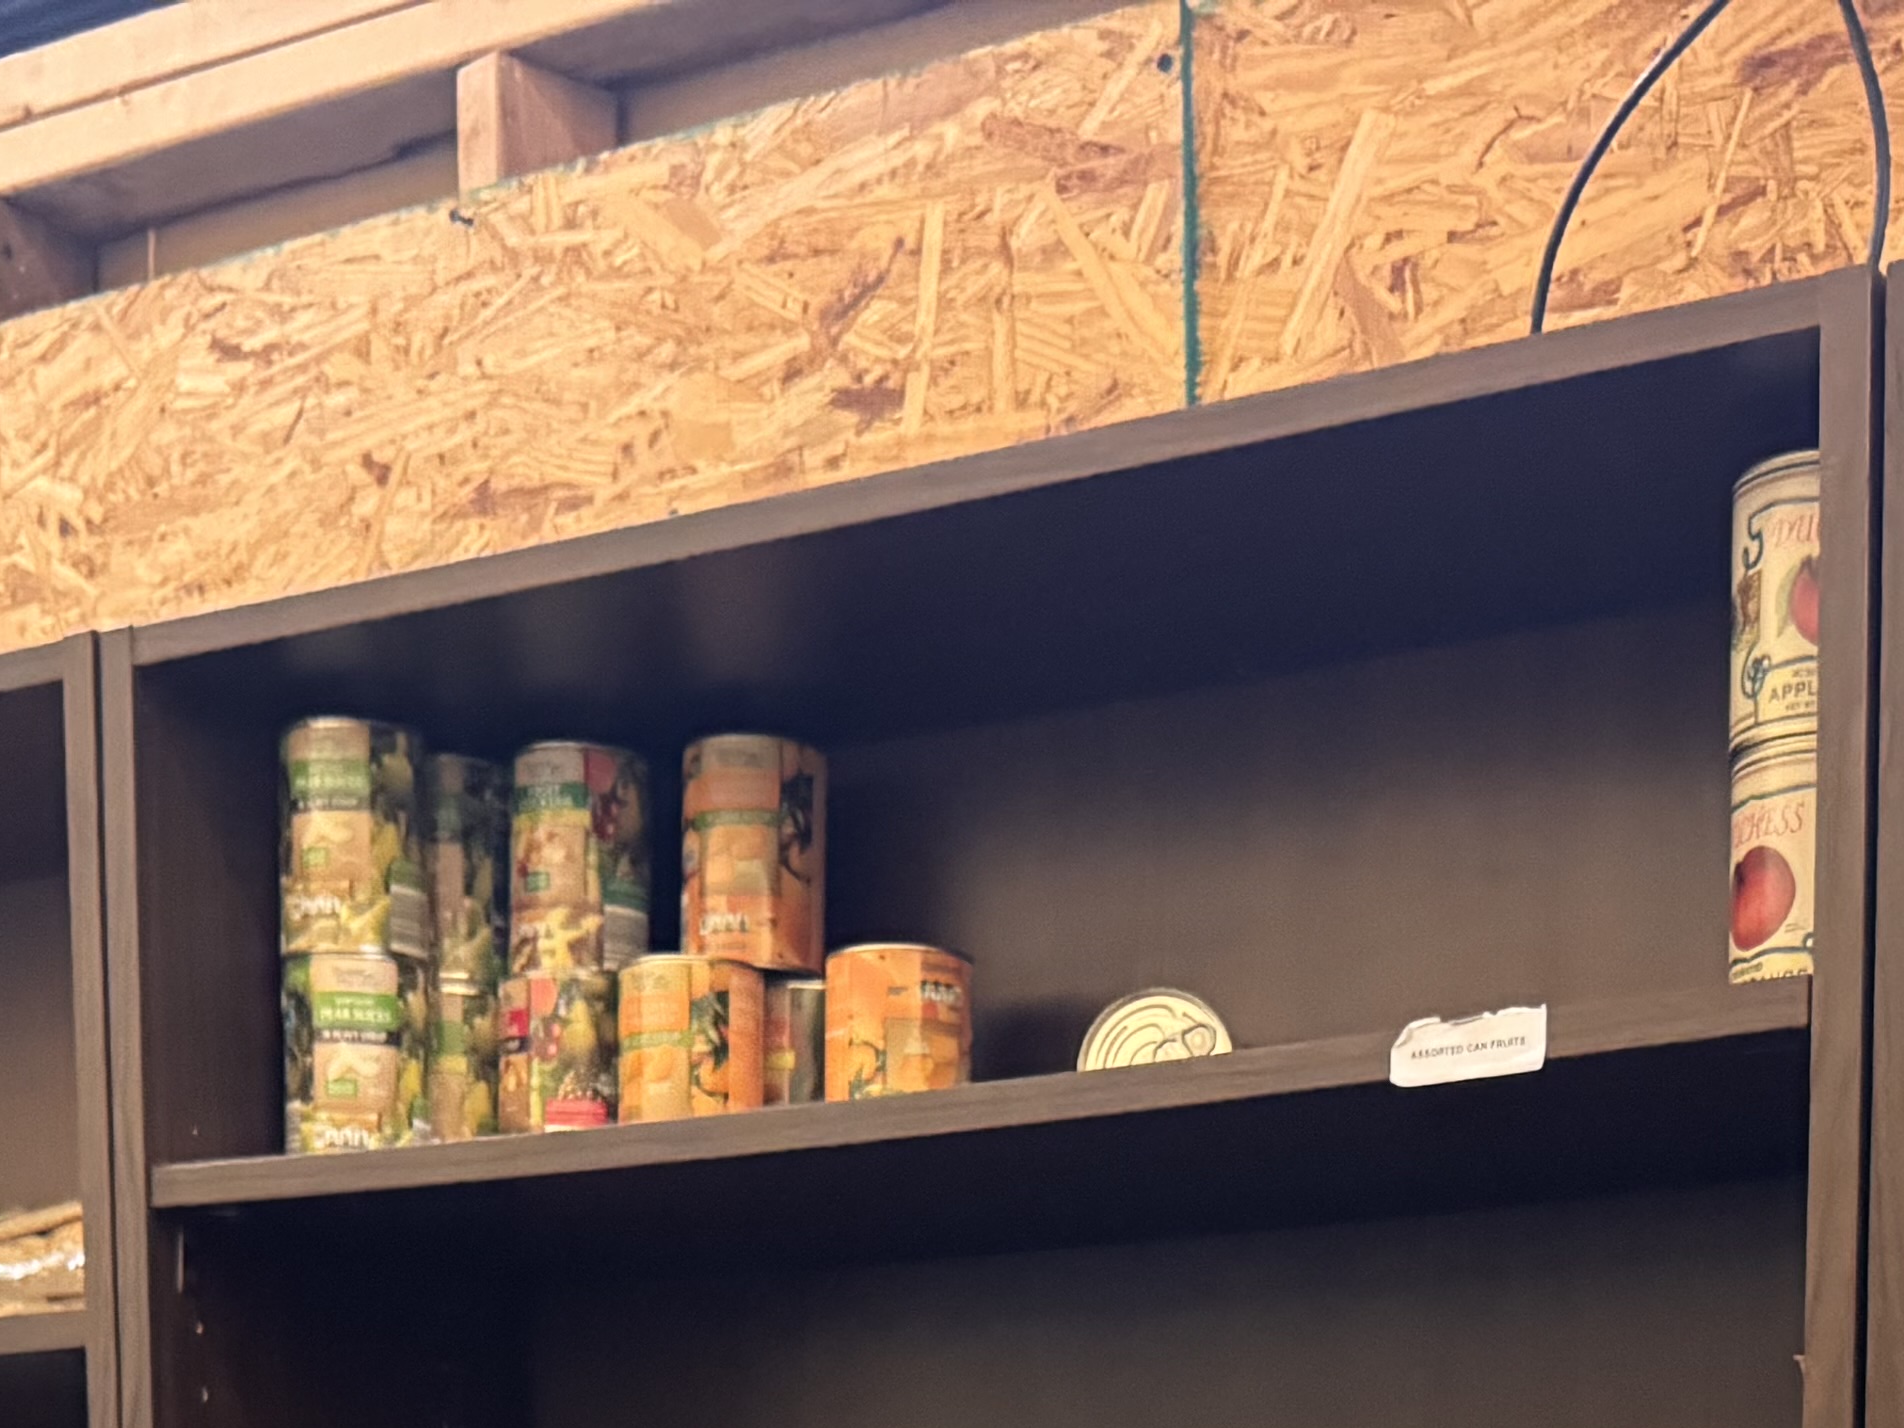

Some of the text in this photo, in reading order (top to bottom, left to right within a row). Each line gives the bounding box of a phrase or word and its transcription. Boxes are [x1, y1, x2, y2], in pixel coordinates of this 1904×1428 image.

[1769, 679, 1816, 703] APPL
[1411, 1036, 1526, 1059] ASSORTED CAN FRUITS
